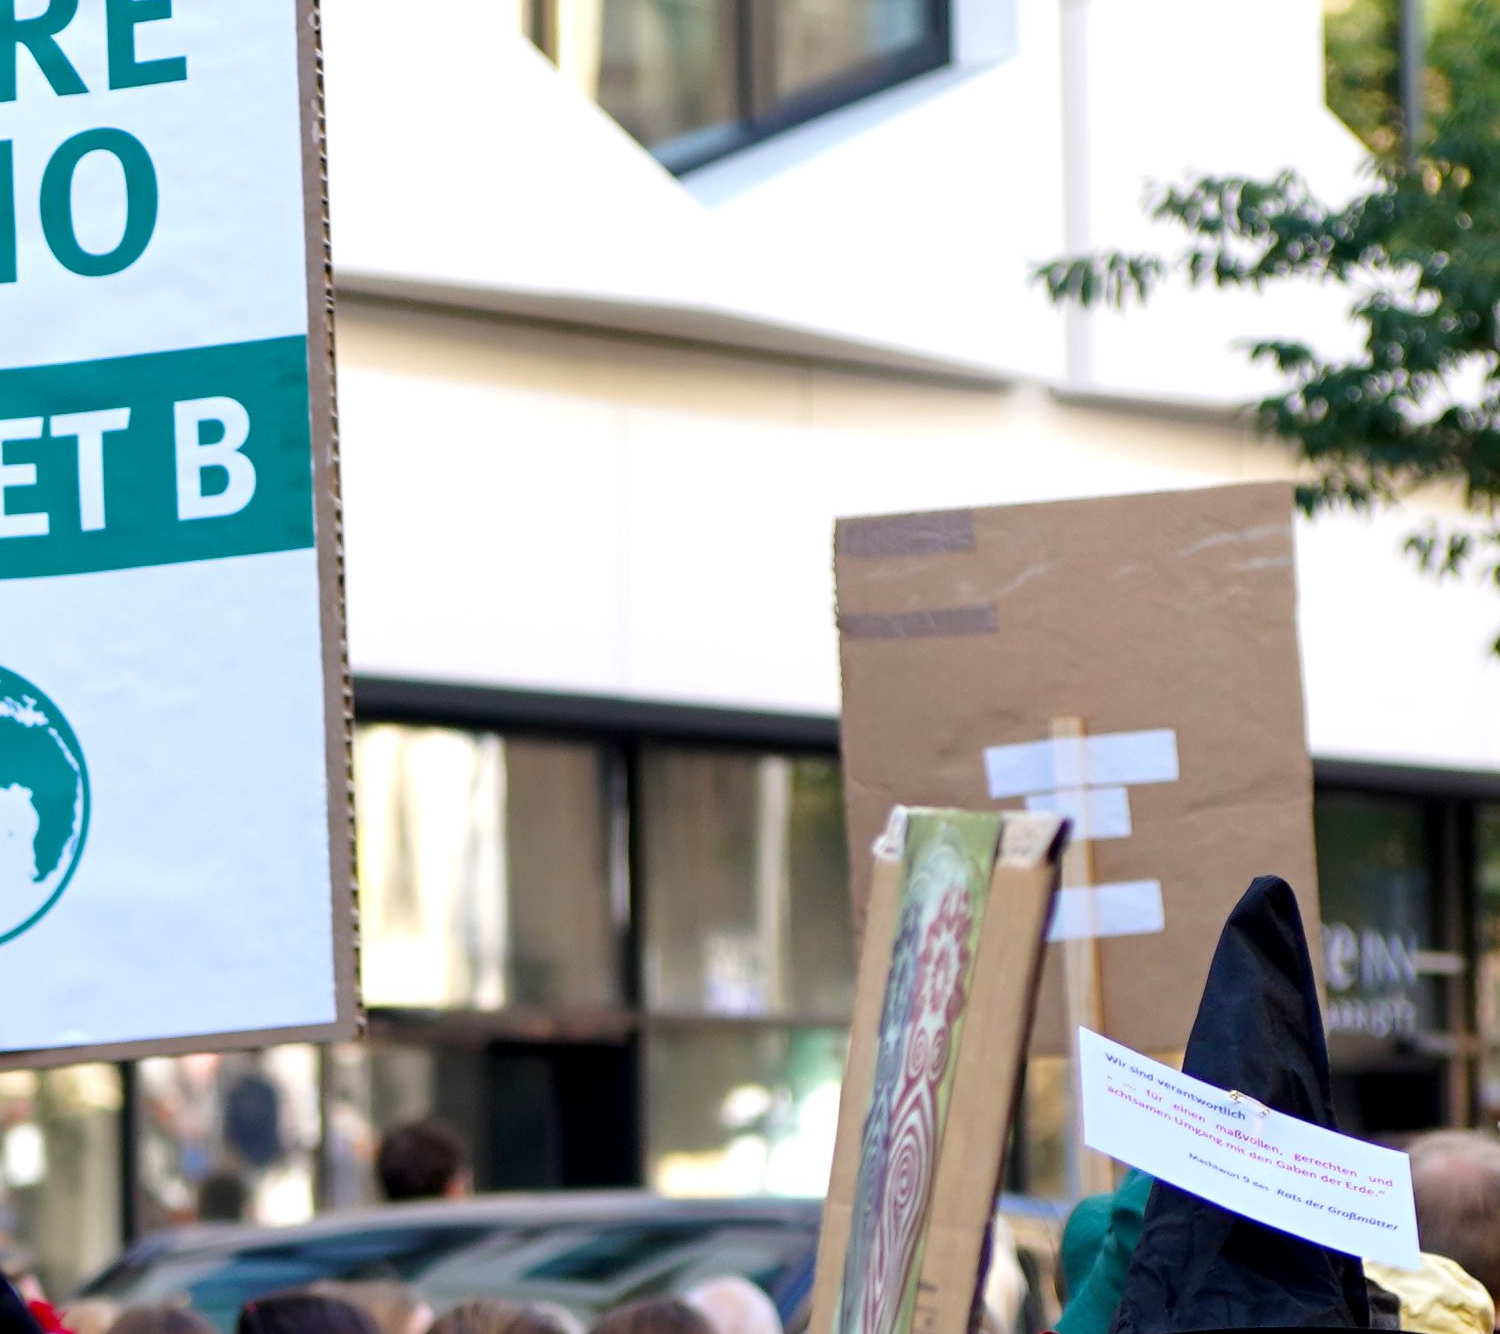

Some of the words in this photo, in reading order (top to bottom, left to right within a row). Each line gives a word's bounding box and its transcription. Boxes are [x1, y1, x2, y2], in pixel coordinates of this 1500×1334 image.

[175, 397, 255, 519] B
[1105, 1052, 1127, 1068] Wir
[1130, 1066, 1154, 1082] sind
[1157, 1078, 1246, 1121] verantwortlich
[1107, 1084, 1171, 1121] achtsamen
[1174, 1115, 1223, 1147] Umgang
[1226, 1142, 1246, 1156] mit
[1249, 1151, 1273, 1165] den
[1275, 1159, 1318, 1180] Gaben
[1320, 1175, 1341, 1186] der
[1144, 1088, 1163, 1103] für
[1173, 1102, 1206, 1124] einen
[1215, 1123, 1284, 1157] maßvollen,
[1294, 1153, 1358, 1178] gerechten
[1368, 1175, 1393, 1187] und
[1276, 1188, 1302, 1204] Rats
[1305, 1198, 1325, 1211] der
[1327, 1205, 1399, 1231] Großmütter
